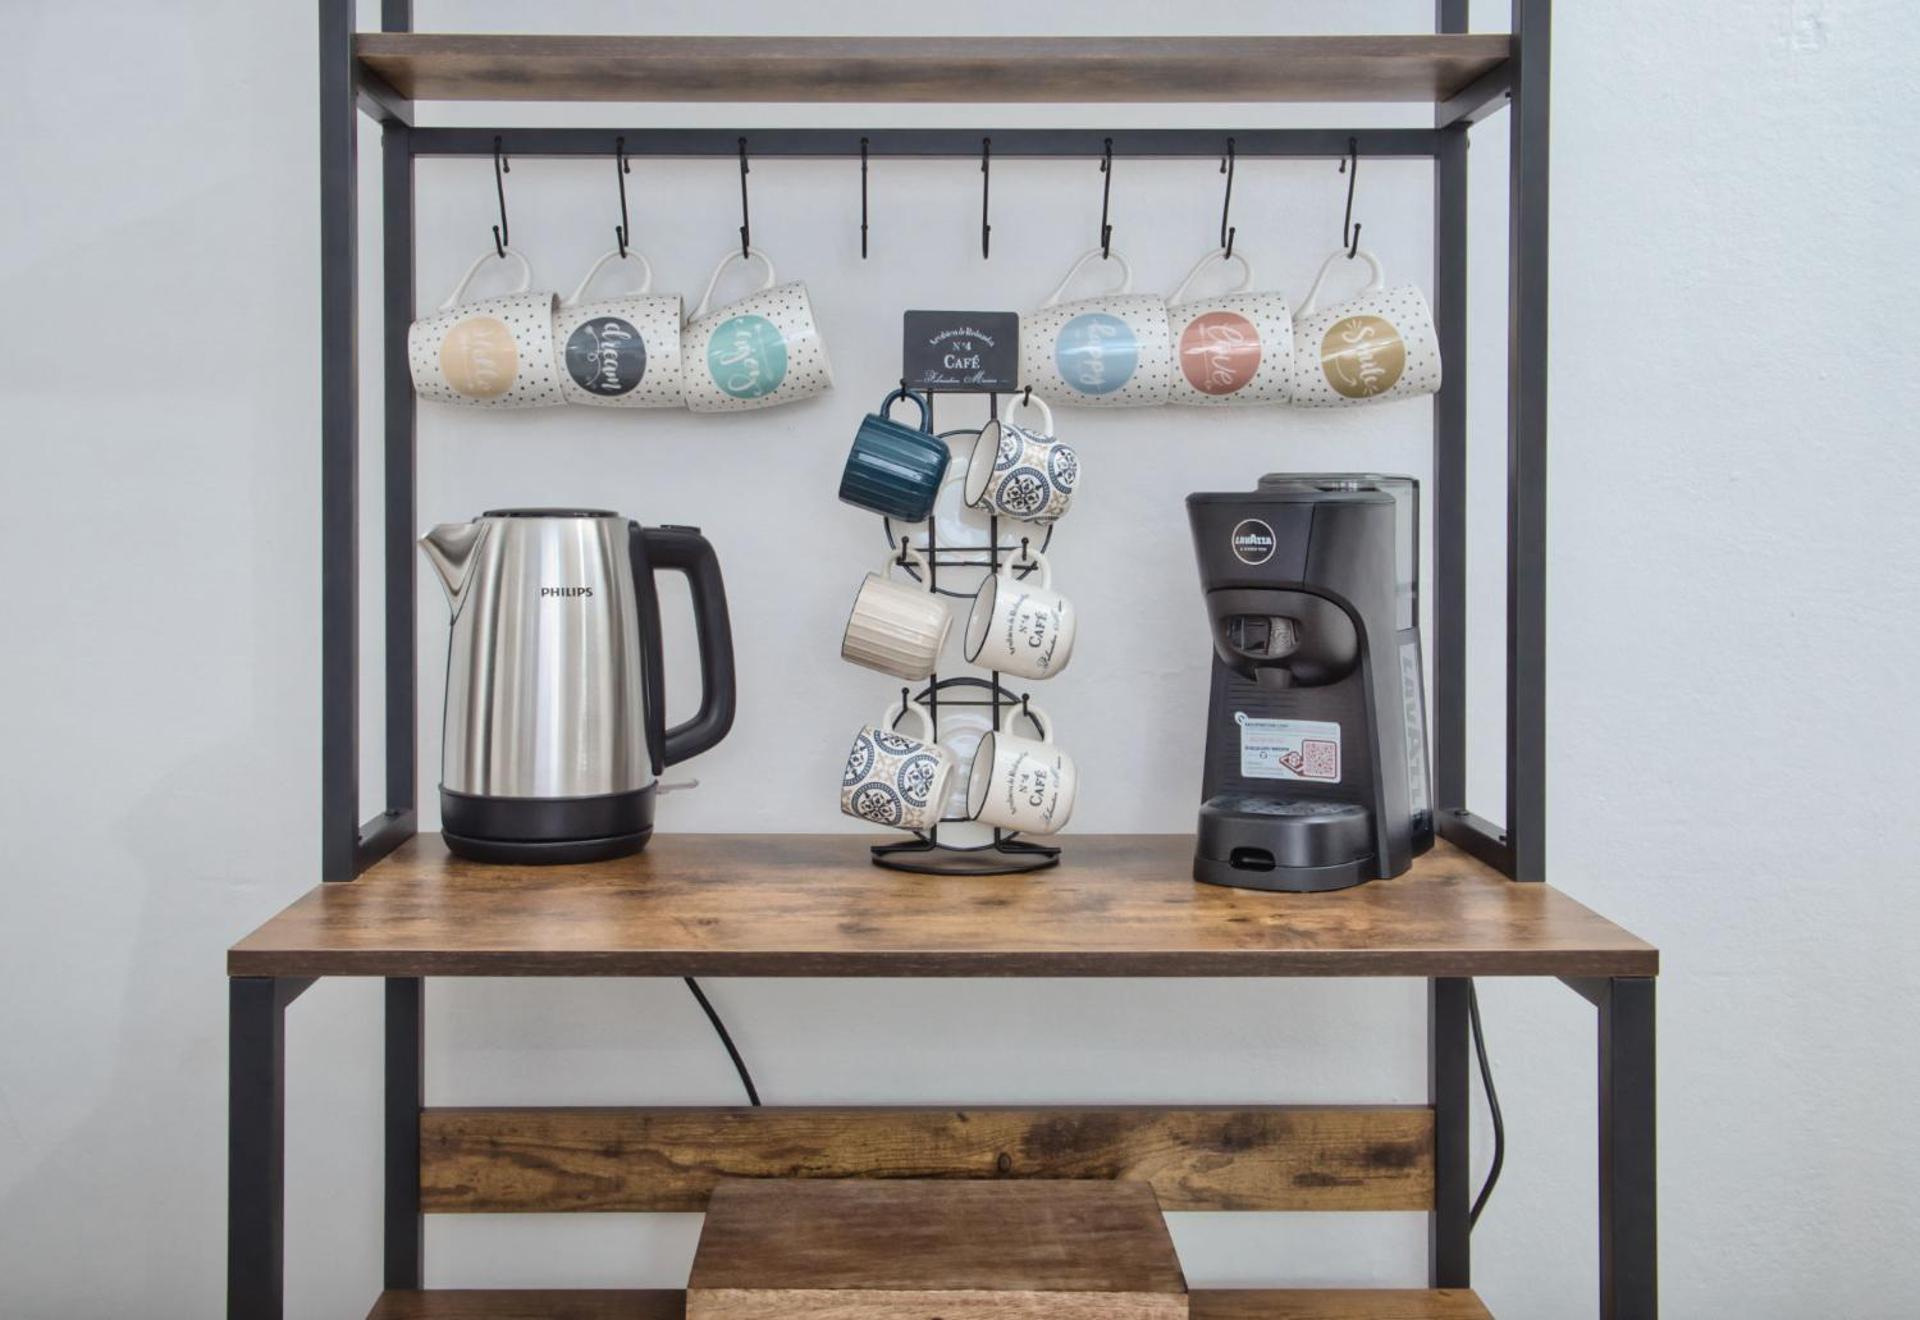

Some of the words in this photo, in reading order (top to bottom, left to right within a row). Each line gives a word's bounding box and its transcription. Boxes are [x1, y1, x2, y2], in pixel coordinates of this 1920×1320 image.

[601, 322, 631, 389] dream
[1235, 533, 1272, 545] LAVAZZA
[541, 587, 593, 597] PHILIPS
[1028, 611, 1047, 648] CAFÉ
[1029, 770, 1047, 807] CAFÉ
